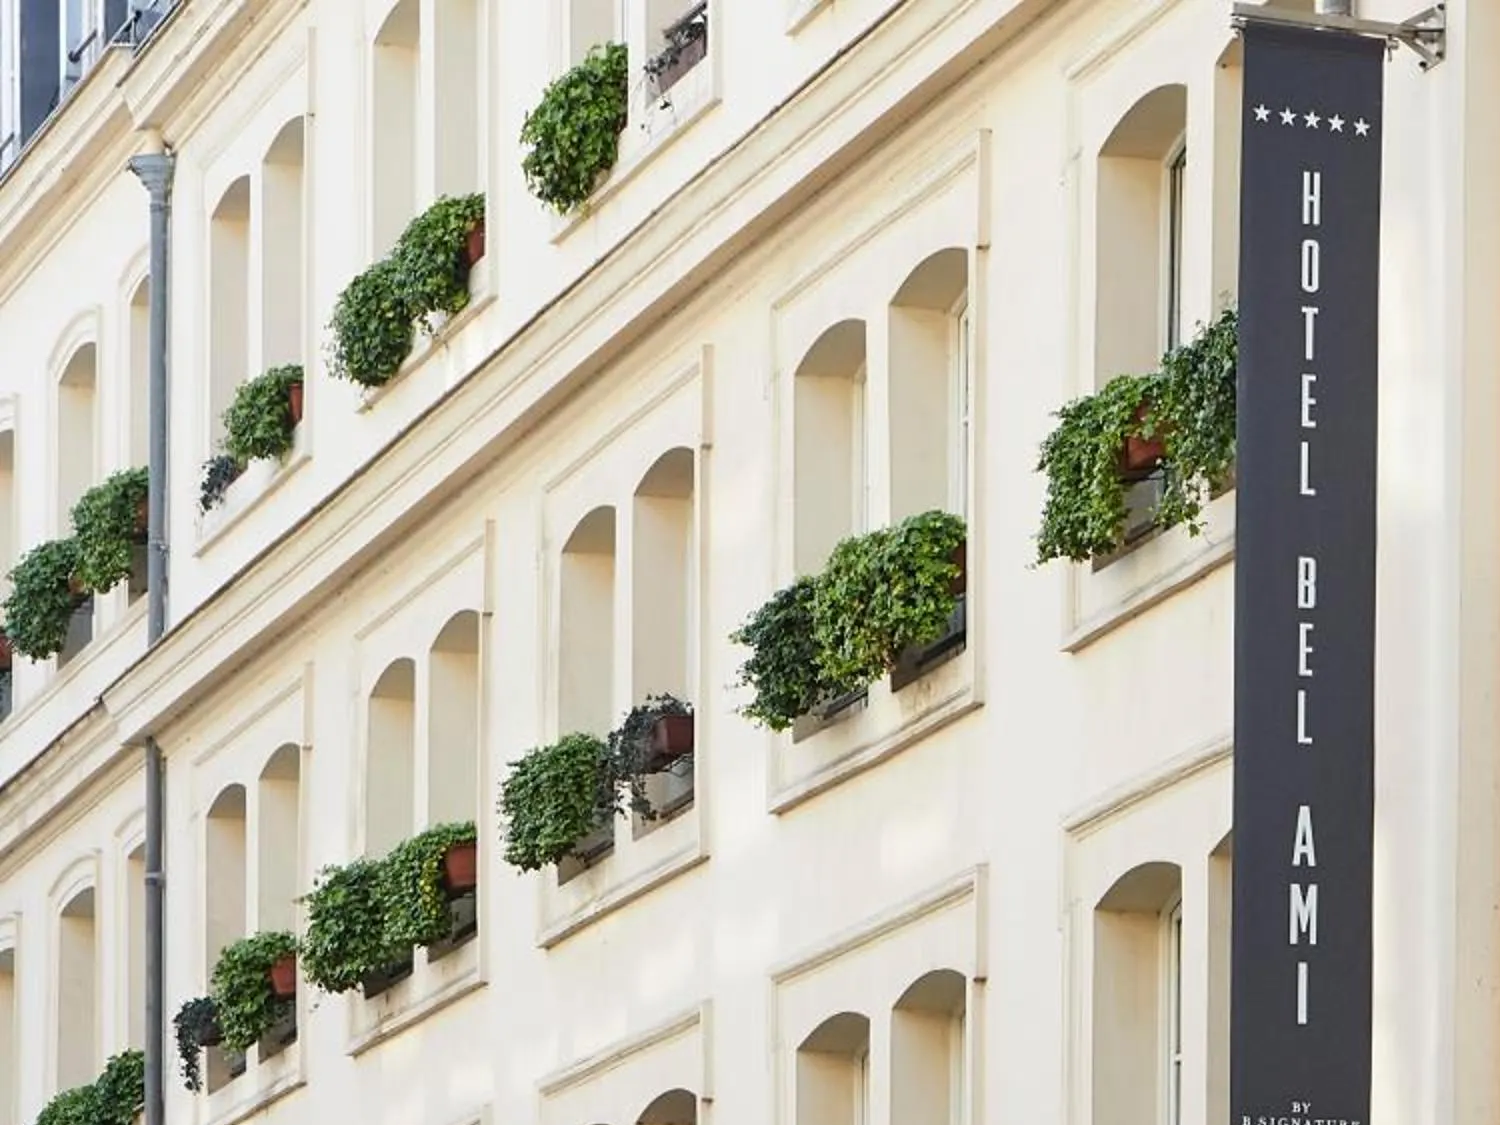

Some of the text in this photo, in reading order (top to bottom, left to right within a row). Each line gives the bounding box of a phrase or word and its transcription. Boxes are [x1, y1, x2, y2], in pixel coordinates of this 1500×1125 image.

[1289, 171, 1321, 1024] HOTEL BEL AMI
[1291, 1101, 1311, 1114] BY
